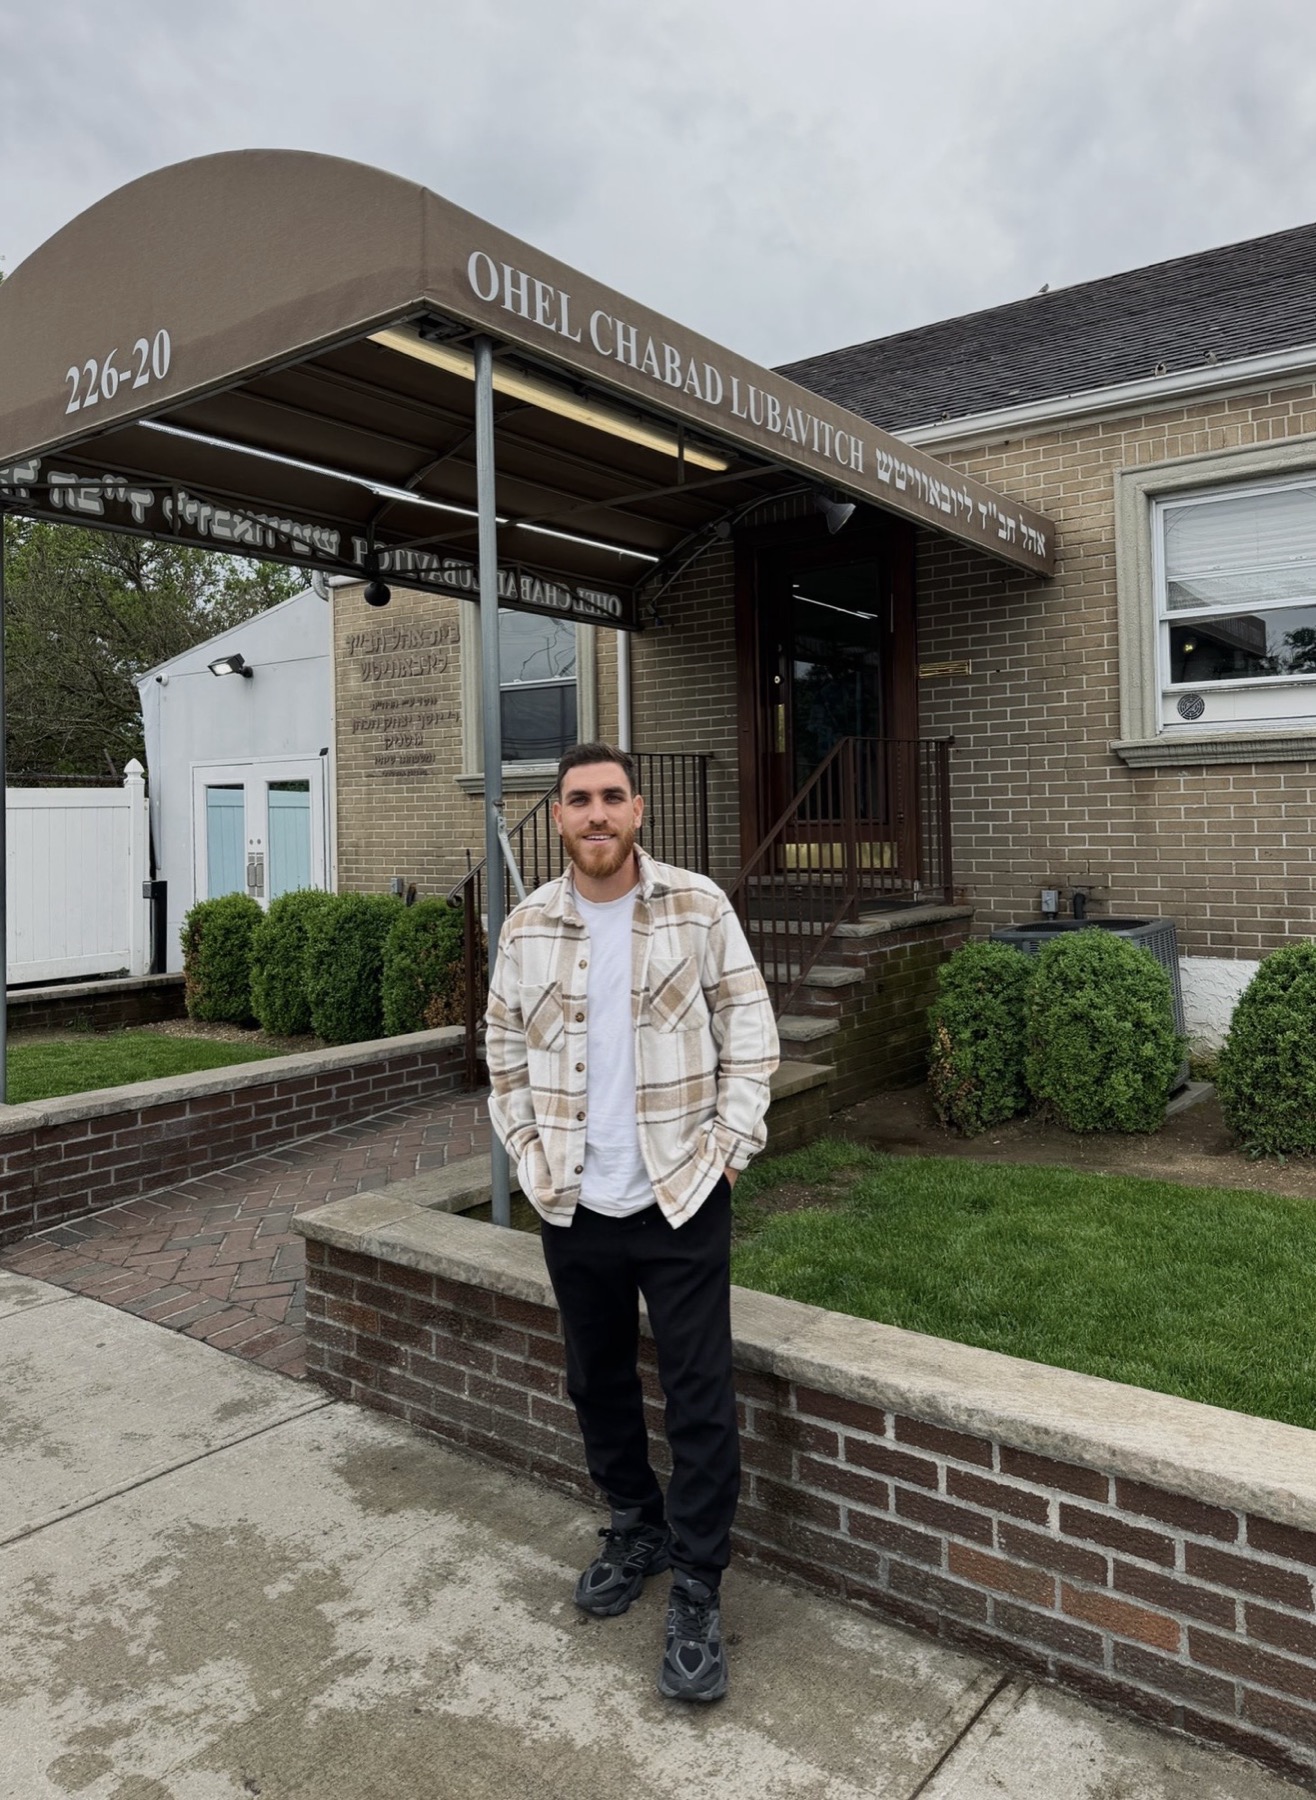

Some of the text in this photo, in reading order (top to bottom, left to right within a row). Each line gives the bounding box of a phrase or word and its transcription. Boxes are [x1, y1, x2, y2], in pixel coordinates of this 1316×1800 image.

[65, 328, 171, 415] 226-20
[467, 251, 866, 474] OHEL CHABAD LUBAVITCH
[875, 447, 973, 524] ליובאוויטש
[1019, 513, 1046, 559] אהל
